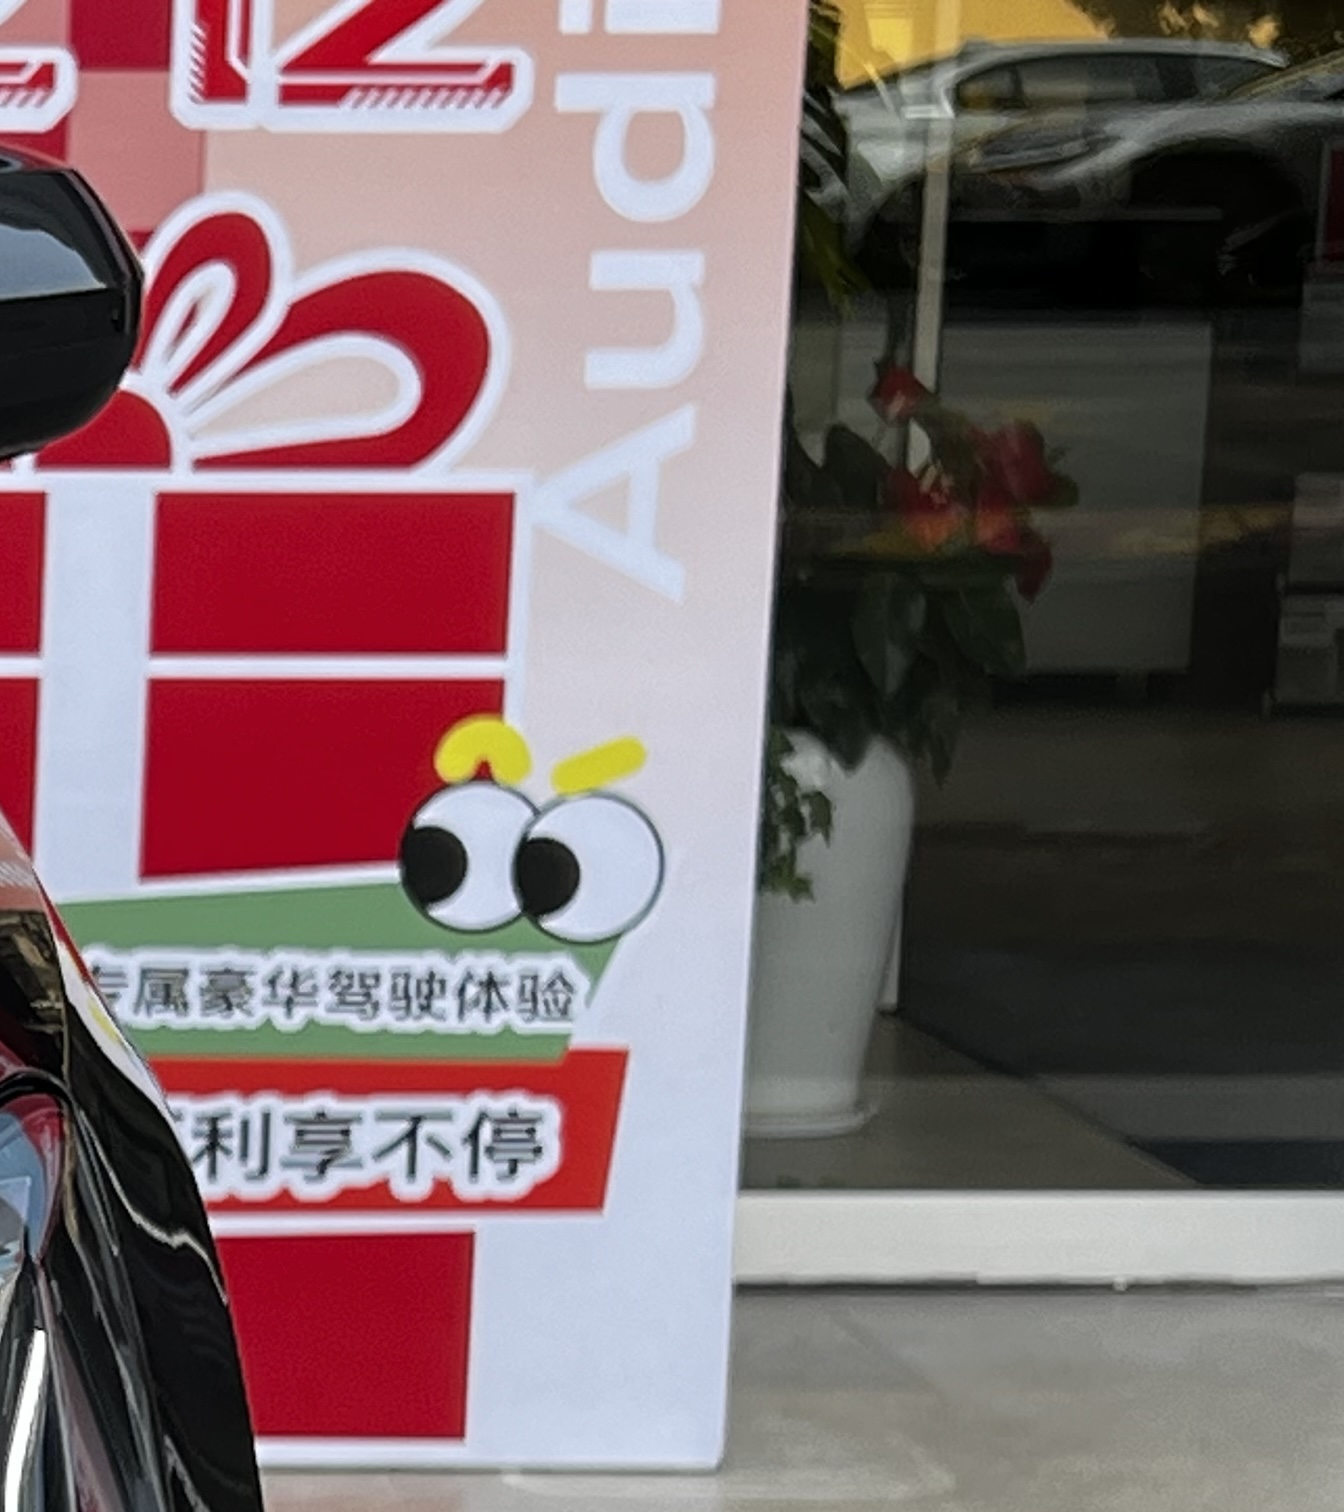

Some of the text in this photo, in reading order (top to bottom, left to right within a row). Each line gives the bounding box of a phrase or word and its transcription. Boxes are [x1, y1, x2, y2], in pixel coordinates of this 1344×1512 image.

[532, 0, 721, 602] Audi
[169, 1100, 548, 1186] 利享不停
